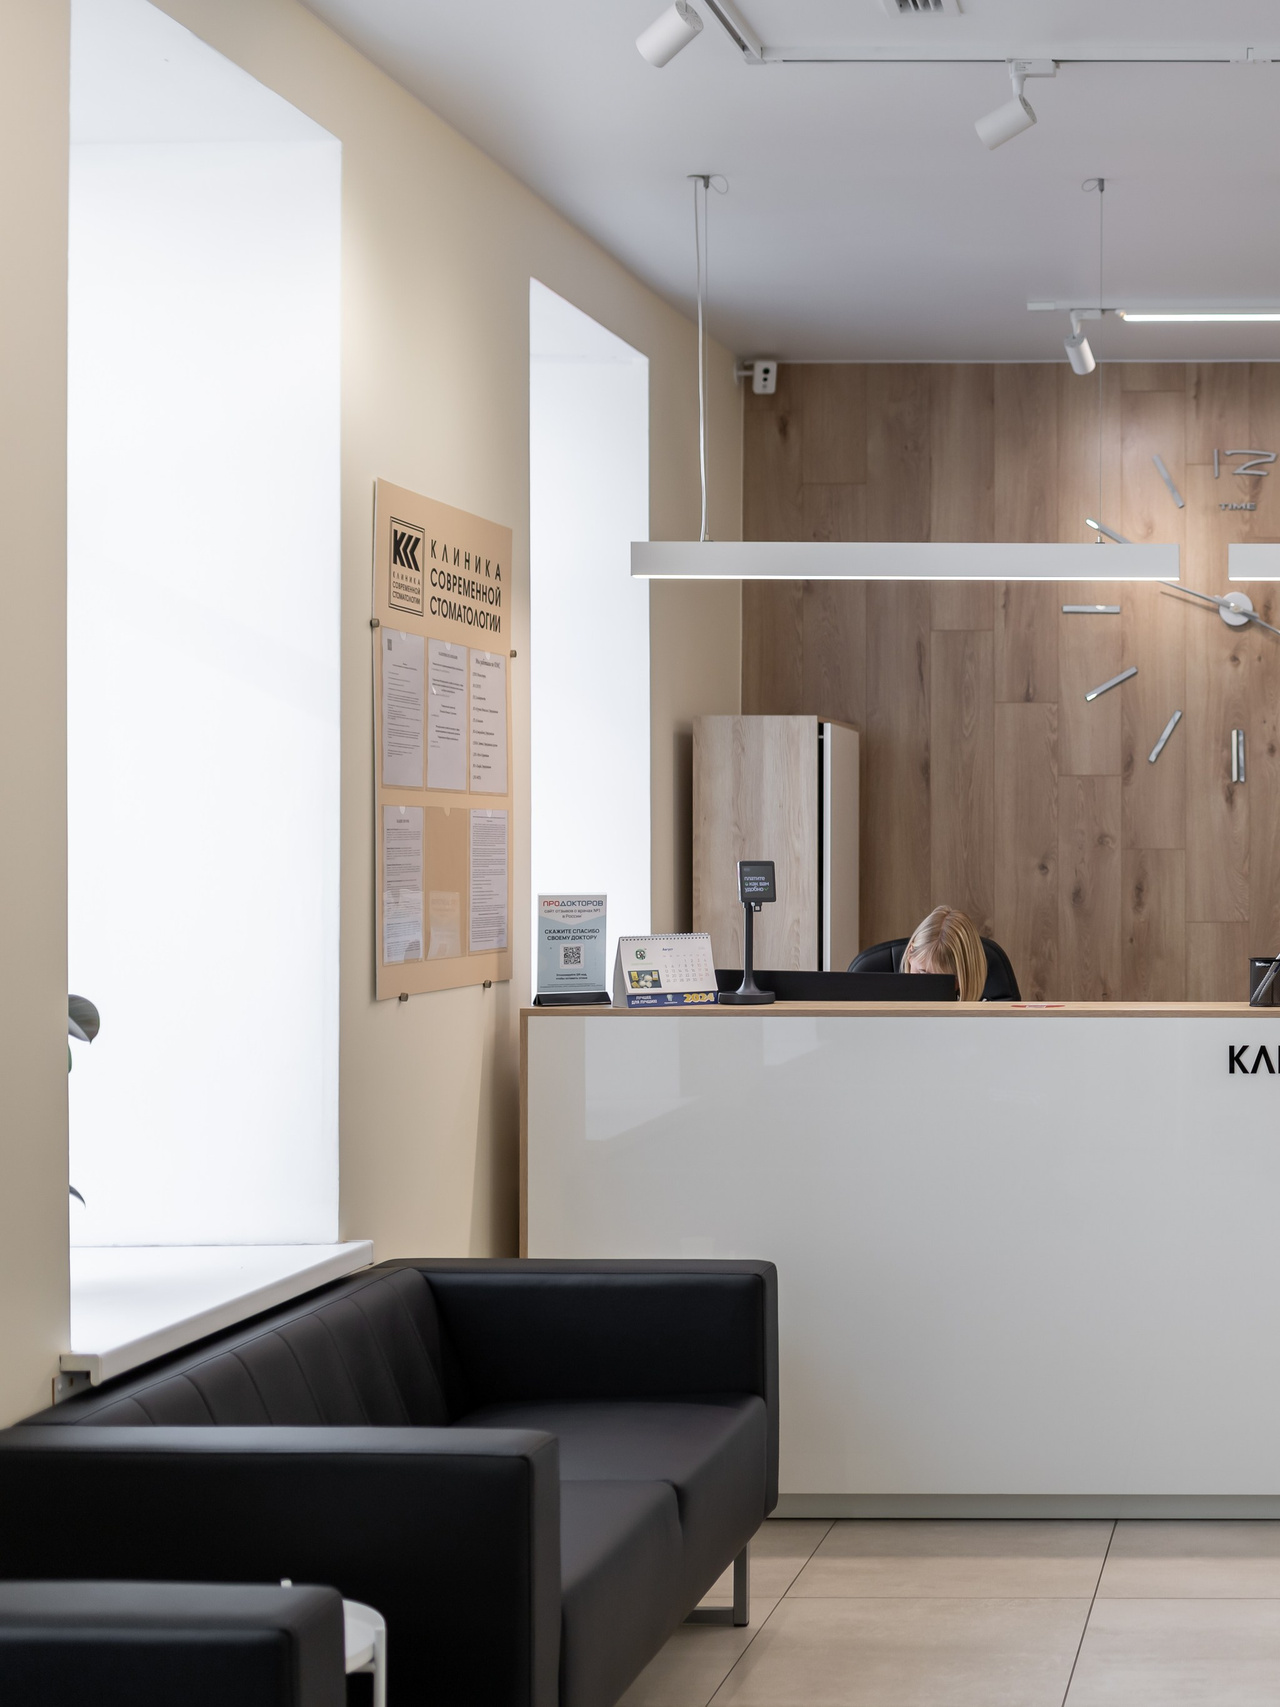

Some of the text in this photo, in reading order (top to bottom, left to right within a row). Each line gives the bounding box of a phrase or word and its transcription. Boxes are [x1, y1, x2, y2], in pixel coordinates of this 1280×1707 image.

[1213, 448, 1279, 479] 12
[1219, 502, 1257, 511] TIME
[430, 538, 502, 582] КЛИНИКА
[430, 567, 501, 607] СОВРЕМЕННОЙ
[429, 595, 501, 634] СТОМАТОЛОГИИ
[683, 992, 715, 1003] 2024
